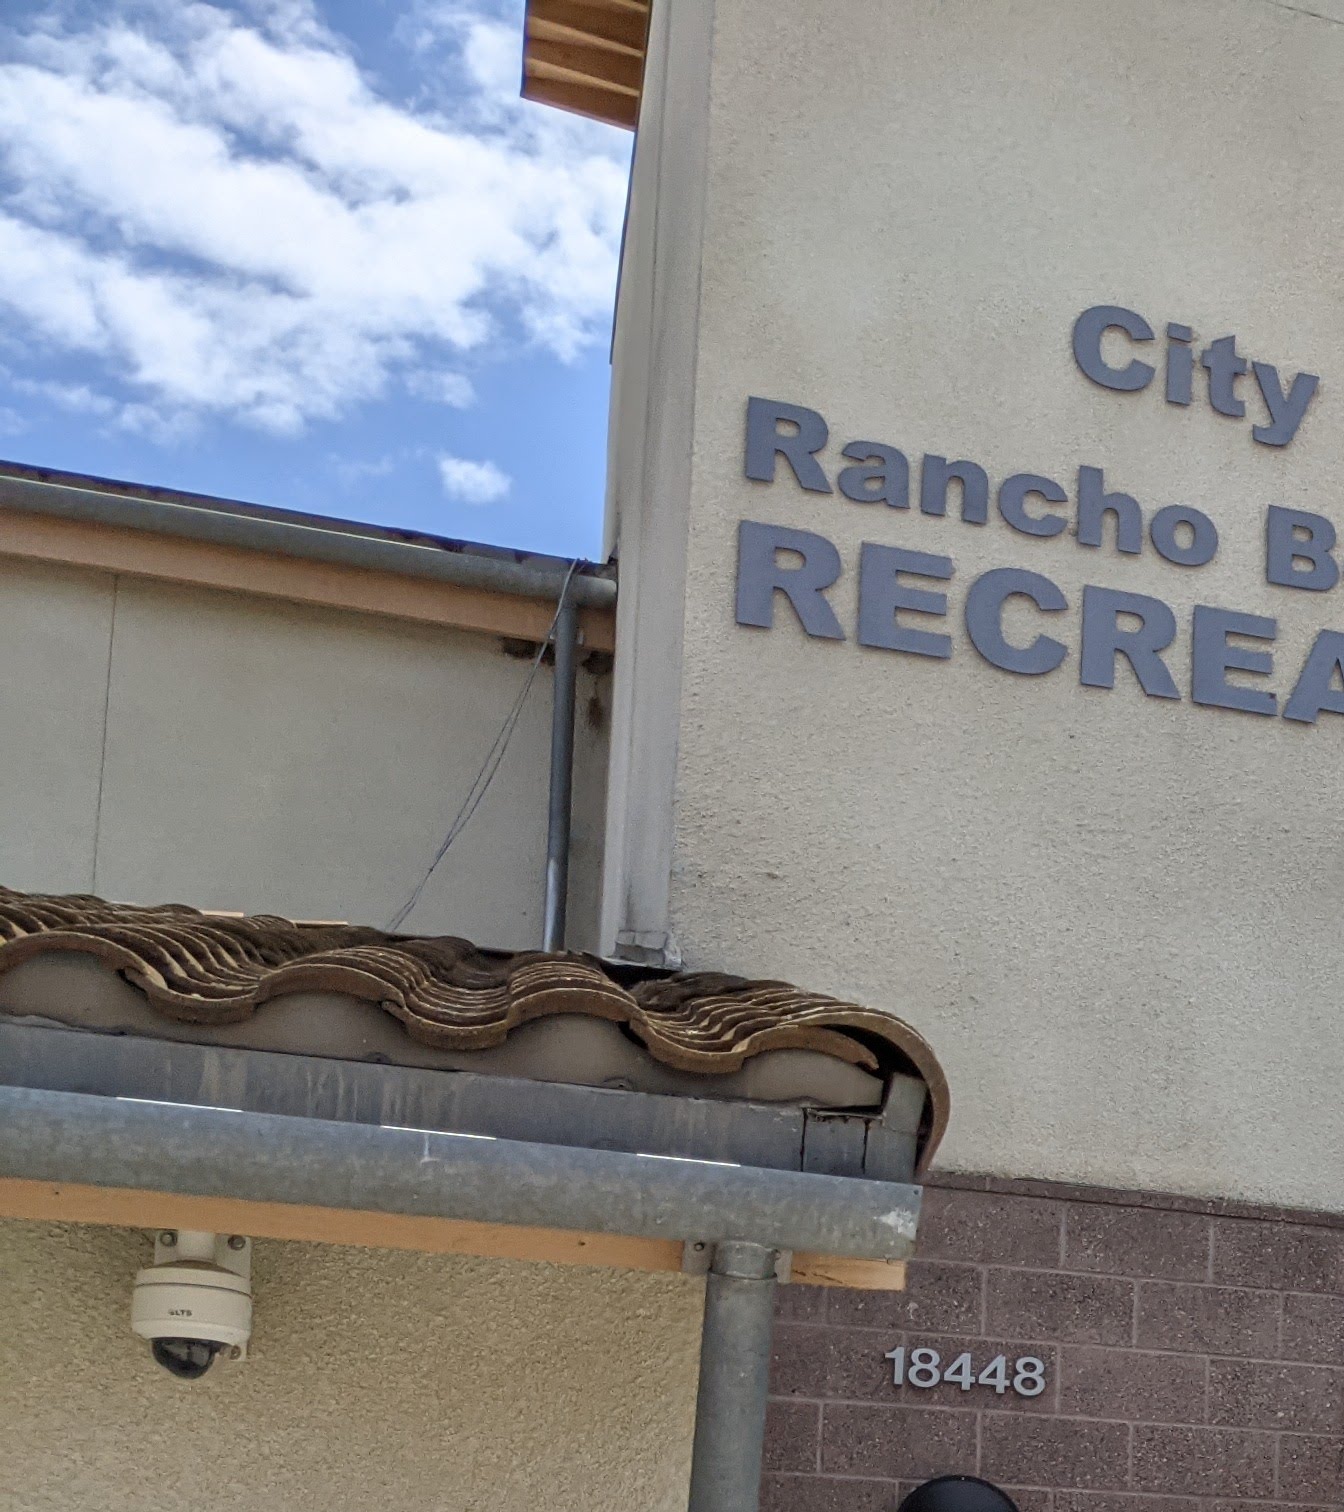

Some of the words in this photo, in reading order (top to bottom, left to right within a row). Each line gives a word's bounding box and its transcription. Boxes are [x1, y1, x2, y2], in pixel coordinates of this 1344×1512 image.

[1072, 305, 1319, 447] City
[745, 396, 1219, 566] Rancho
[885, 1347, 1046, 1396] 18448
